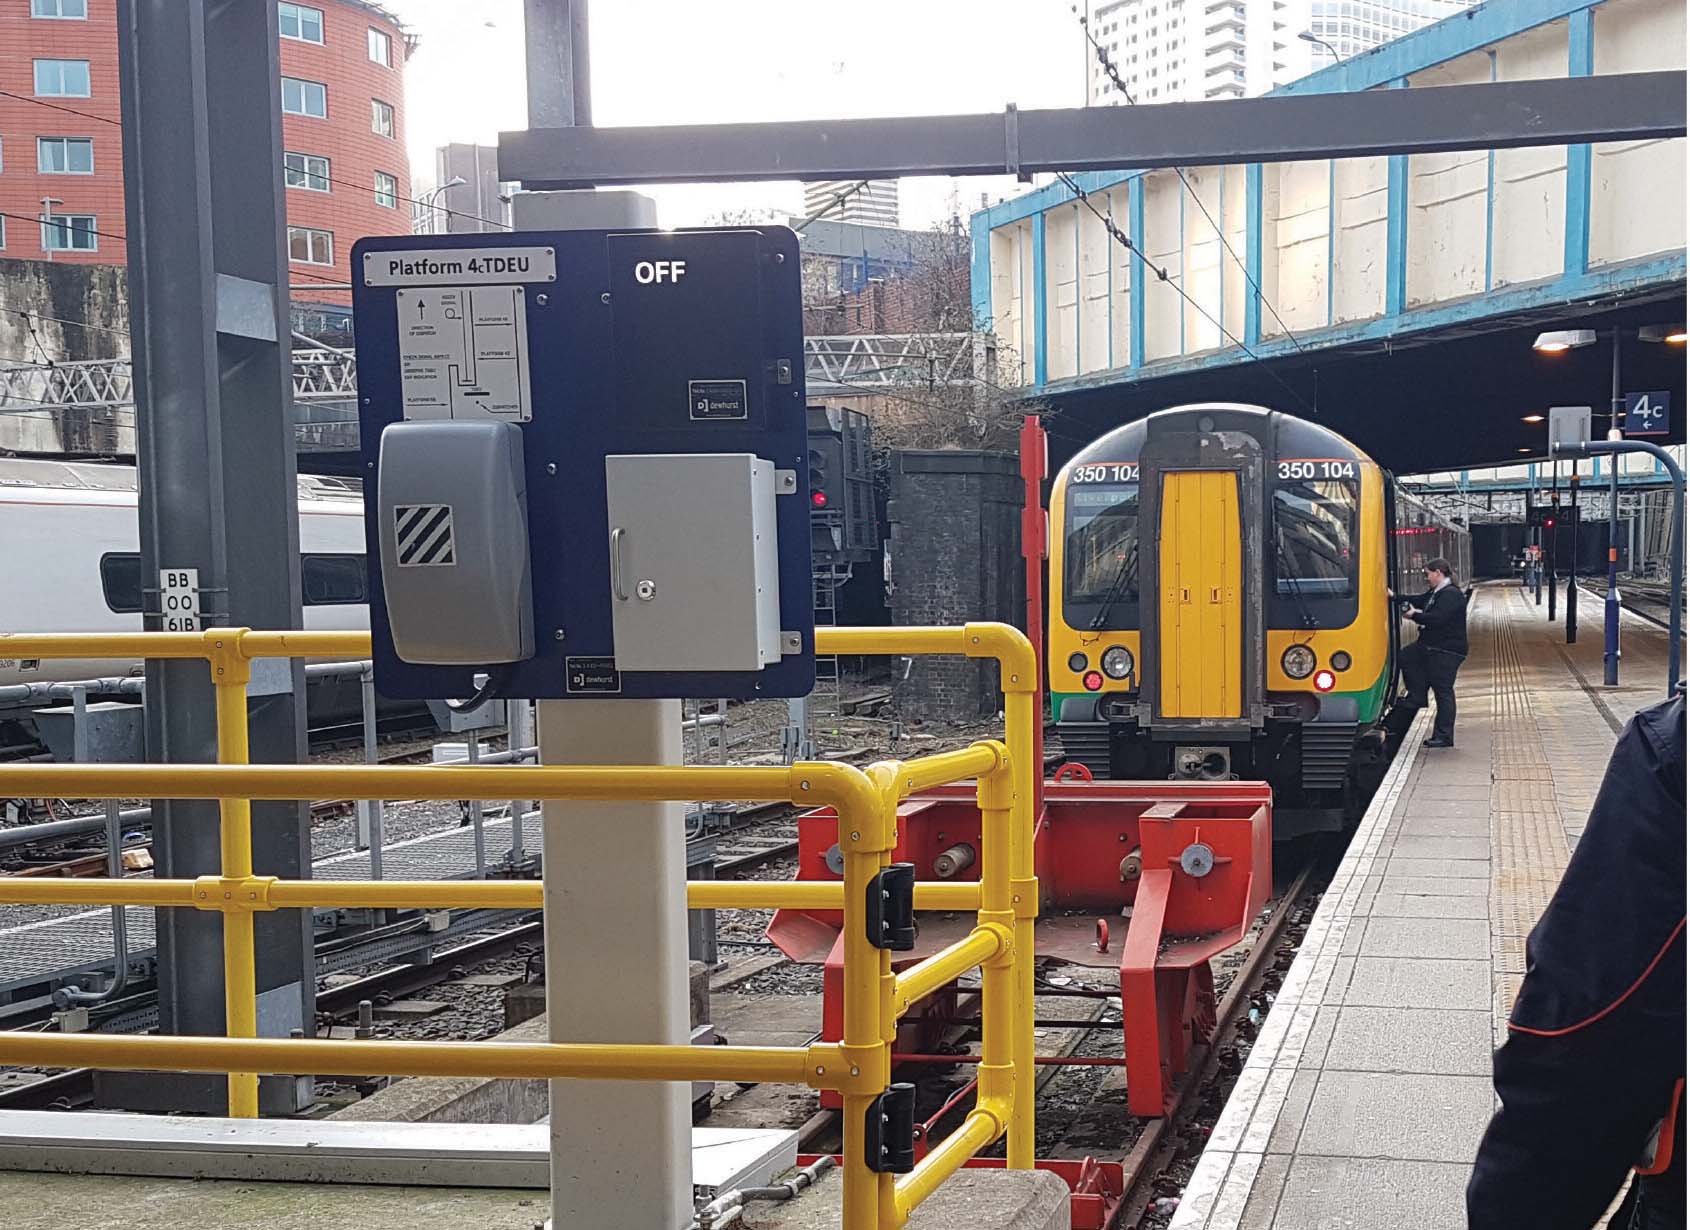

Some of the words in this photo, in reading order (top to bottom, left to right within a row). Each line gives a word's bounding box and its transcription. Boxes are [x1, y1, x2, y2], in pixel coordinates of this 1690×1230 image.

[389, 258, 462, 275] Platform
[635, 261, 686, 283] OFF
[710, 401, 739, 409] dewhurst
[1632, 395, 1663, 418] 4c
[1073, 466, 1106, 482] 350
[1112, 465, 1139, 481] 104
[1278, 462, 1315, 479] 350
[1321, 462, 1354, 478] 104
[168, 573, 188, 587] BB
